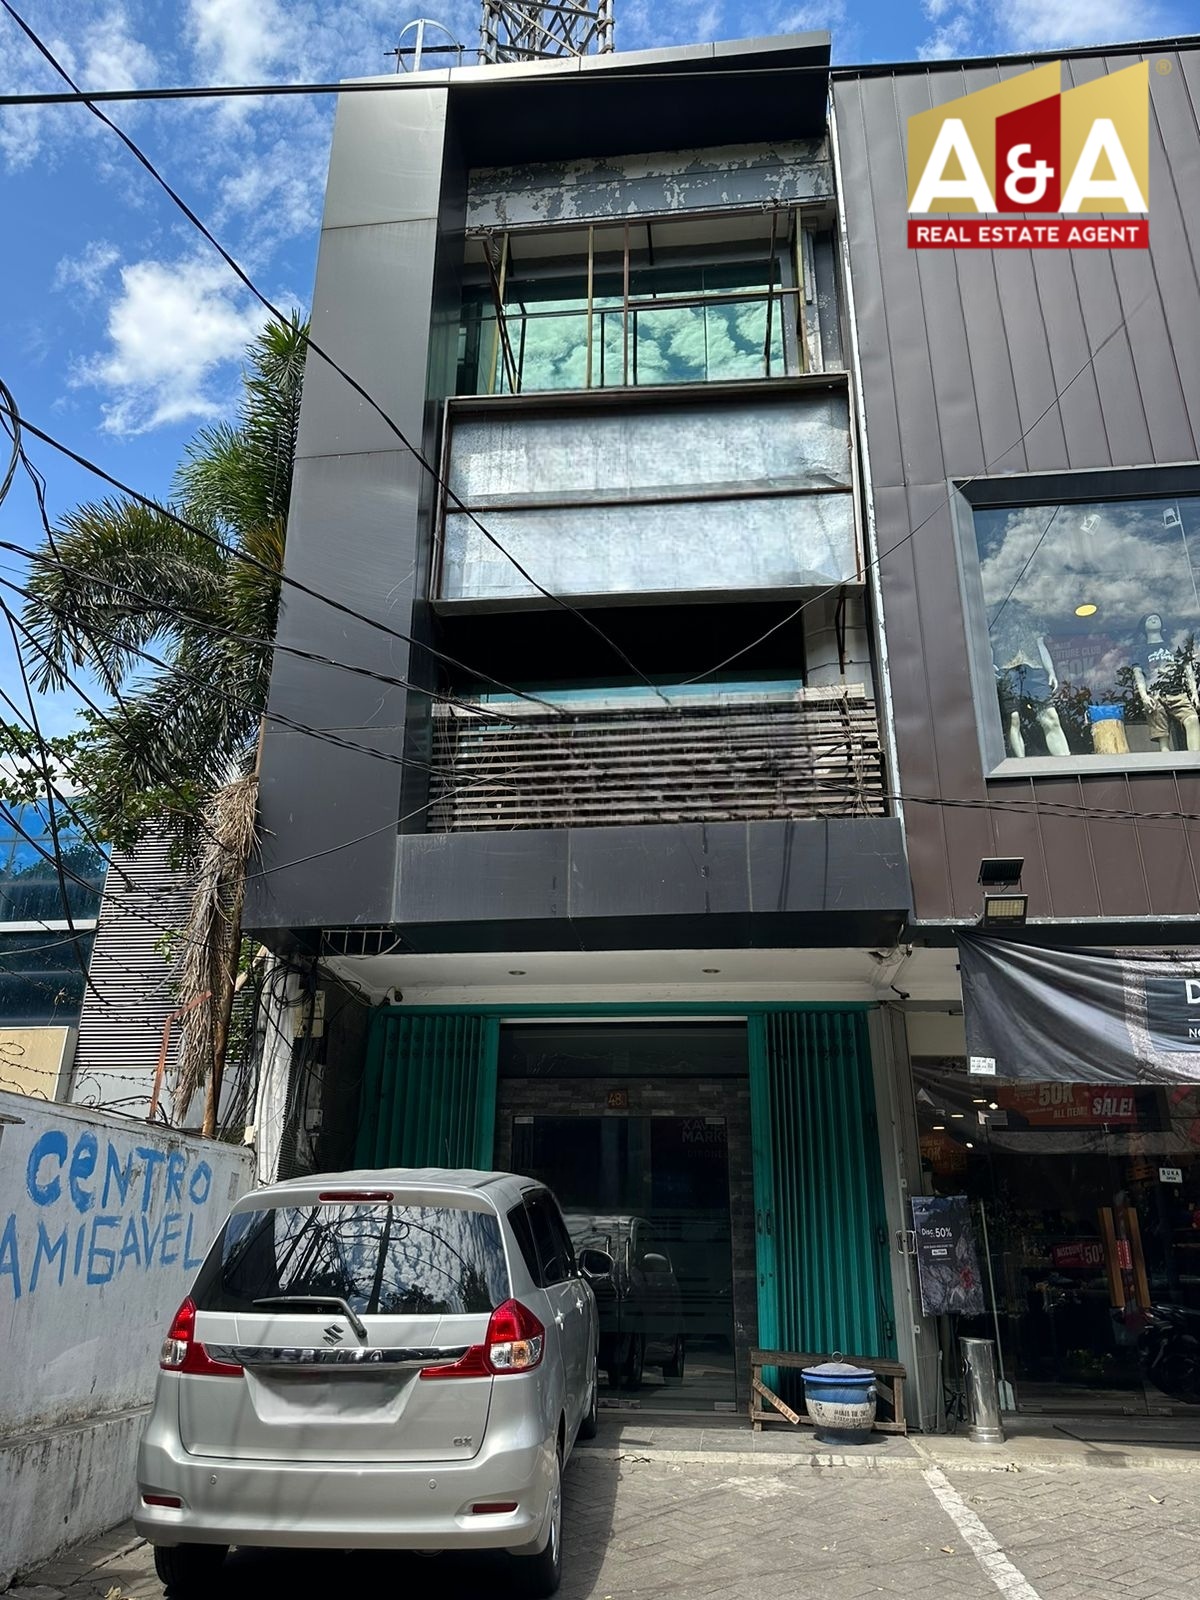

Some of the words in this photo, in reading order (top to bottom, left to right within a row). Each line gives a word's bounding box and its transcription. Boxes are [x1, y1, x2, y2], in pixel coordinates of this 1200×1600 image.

[1038, 1083, 1075, 1106] 50K
[1092, 1097, 1134, 1117] SALE!
[935, 1227, 953, 1238] 50%
